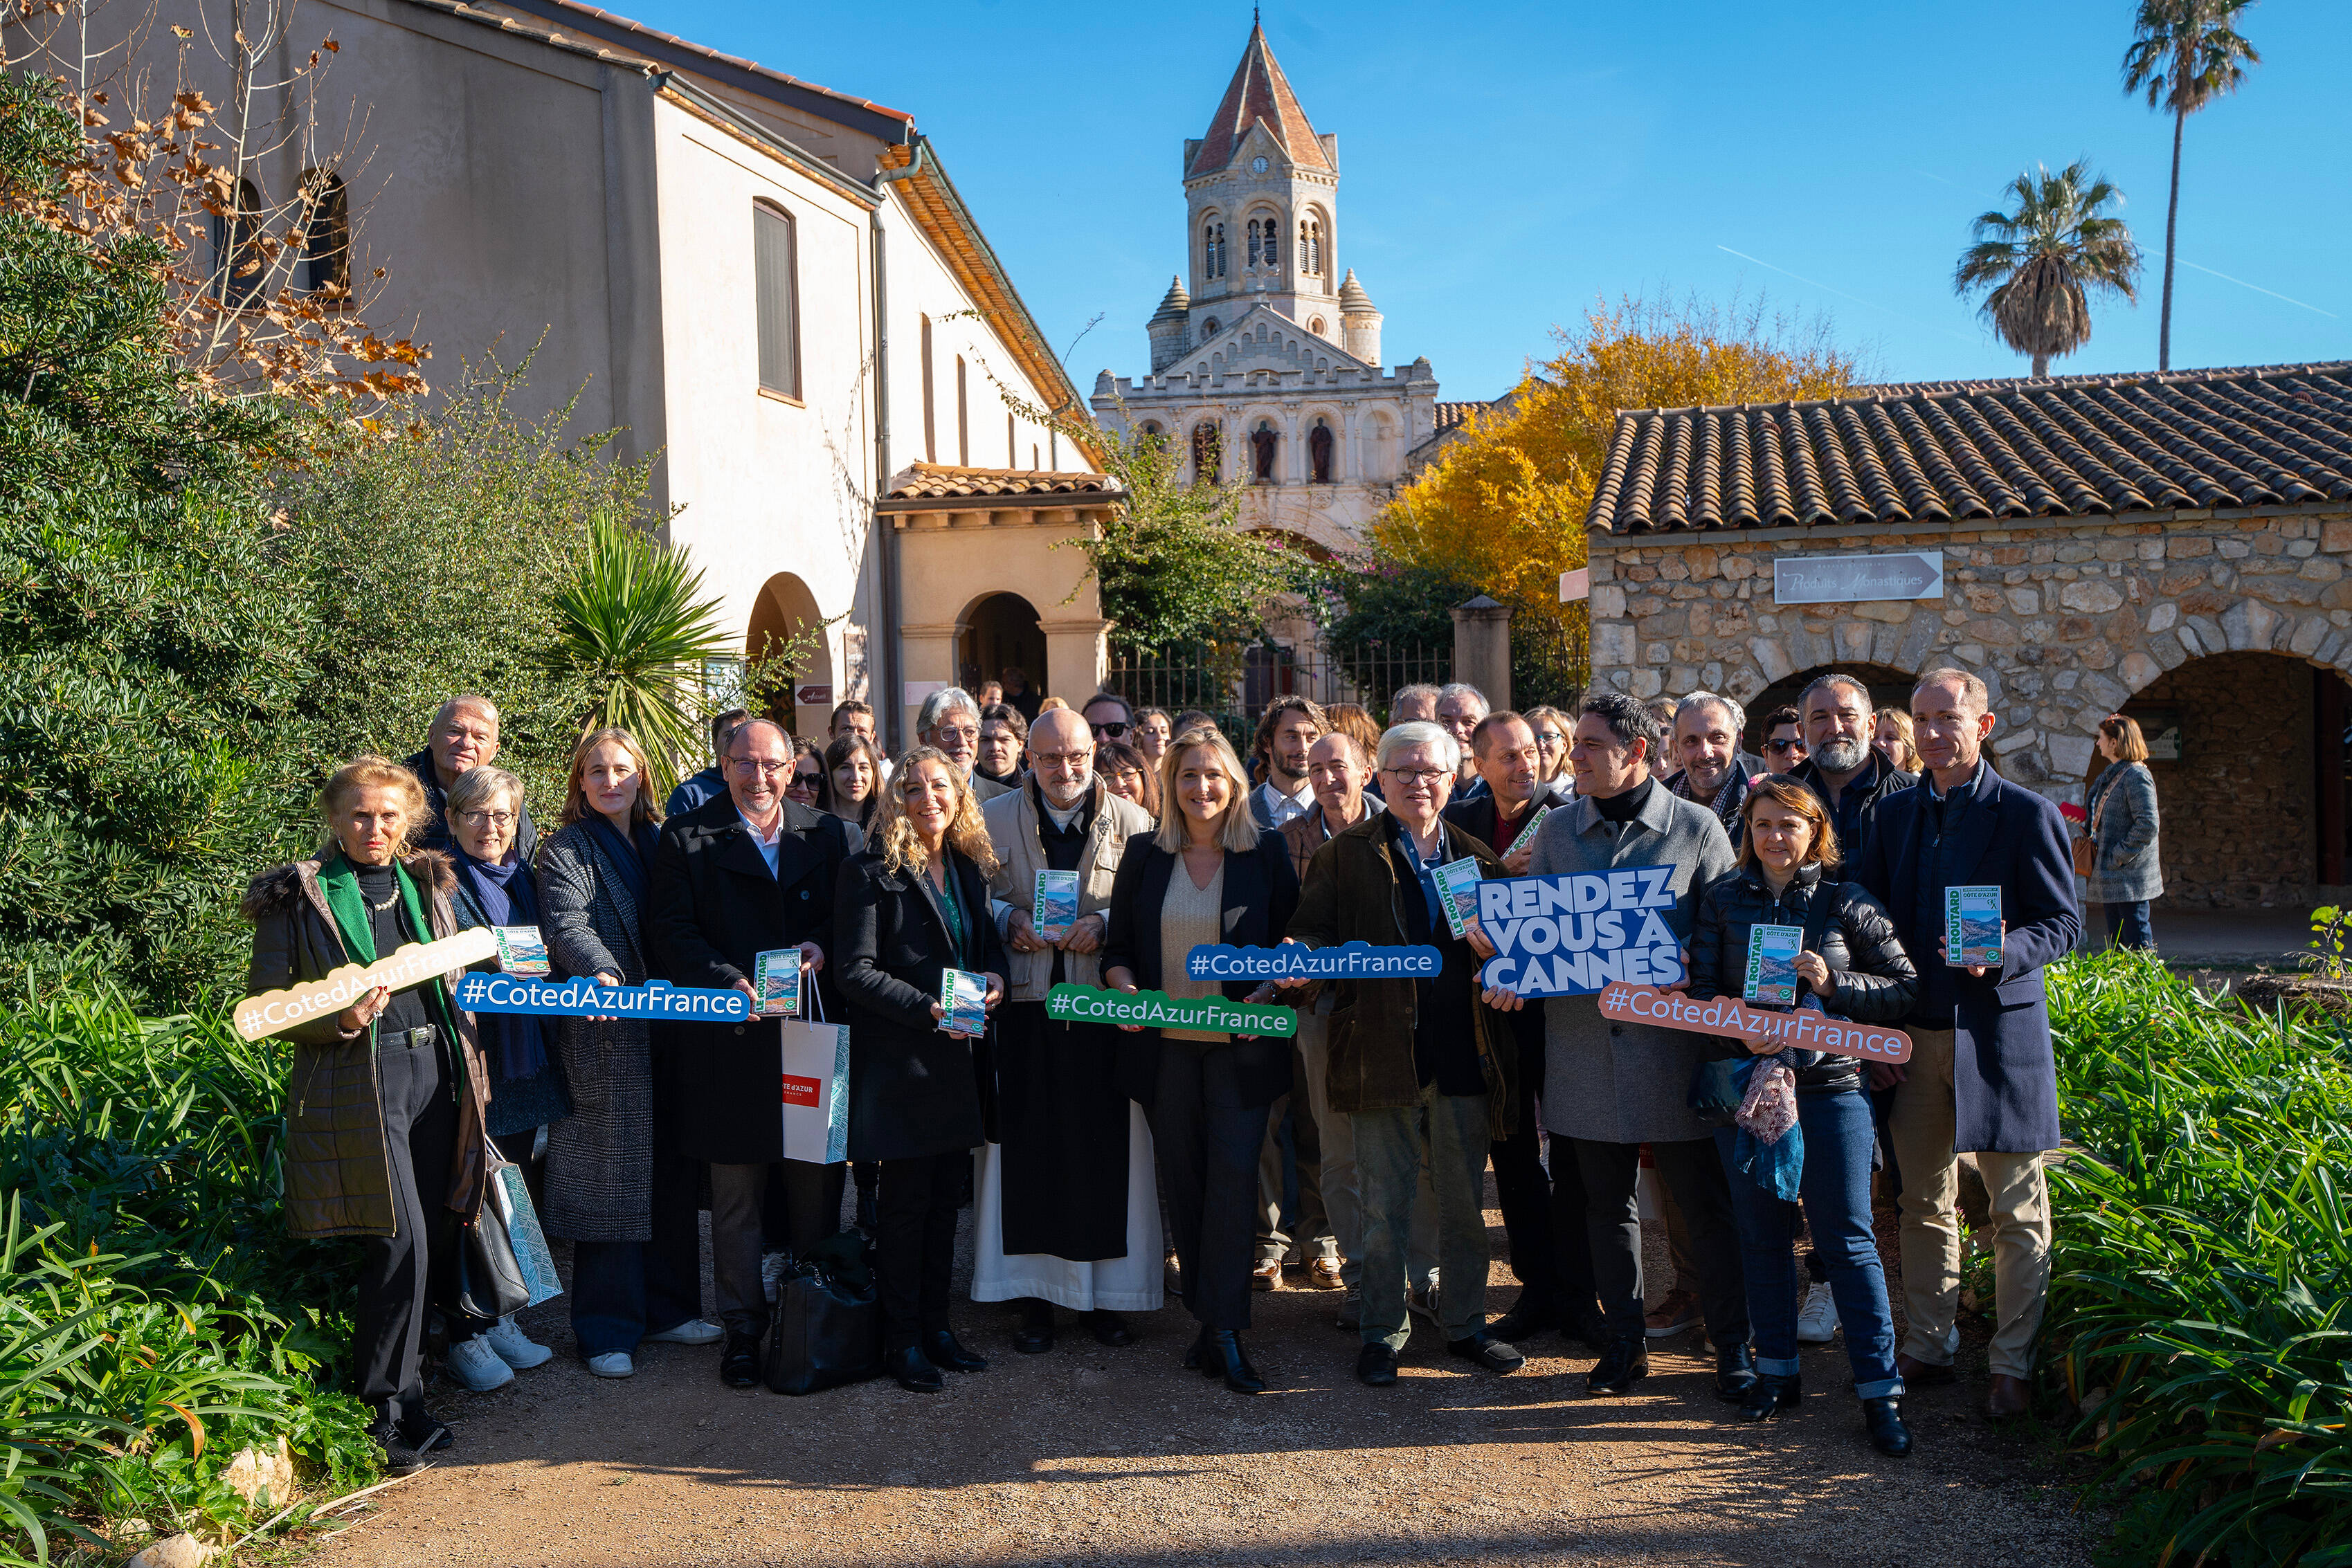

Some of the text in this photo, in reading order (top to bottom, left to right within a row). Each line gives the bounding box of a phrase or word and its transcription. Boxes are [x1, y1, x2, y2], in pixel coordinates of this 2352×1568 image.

[1782, 572, 1924, 591] Produits Monastiques
[1513, 809, 1547, 850] ROUTARD
[1035, 873, 1046, 922] ROUTARD
[1436, 870, 1459, 920] ROUTARD
[1478, 868, 1672, 921] RENDEZ
[1453, 921, 1464, 934] LE
[1483, 907, 1676, 958] VOUS À
[1950, 890, 1961, 960] LE ROUTARD
[496, 928, 514, 969] LE ROUTARD
[1191, 952, 1433, 976] #CotedAzurFrance
[1484, 945, 1681, 994] CANNES
[1746, 927, 1764, 997] LE ROUTARD
[462, 978, 743, 1014] #CotedAzurFrance
[756, 954, 768, 1011] LE ROUTARD
[944, 972, 955, 1013] ROUTARD
[1051, 992, 1288, 1031] #CotedAzurFrance
[1606, 987, 1902, 1055] #CotedAzurFrance
[790, 1084, 813, 1093] d'AZUR
